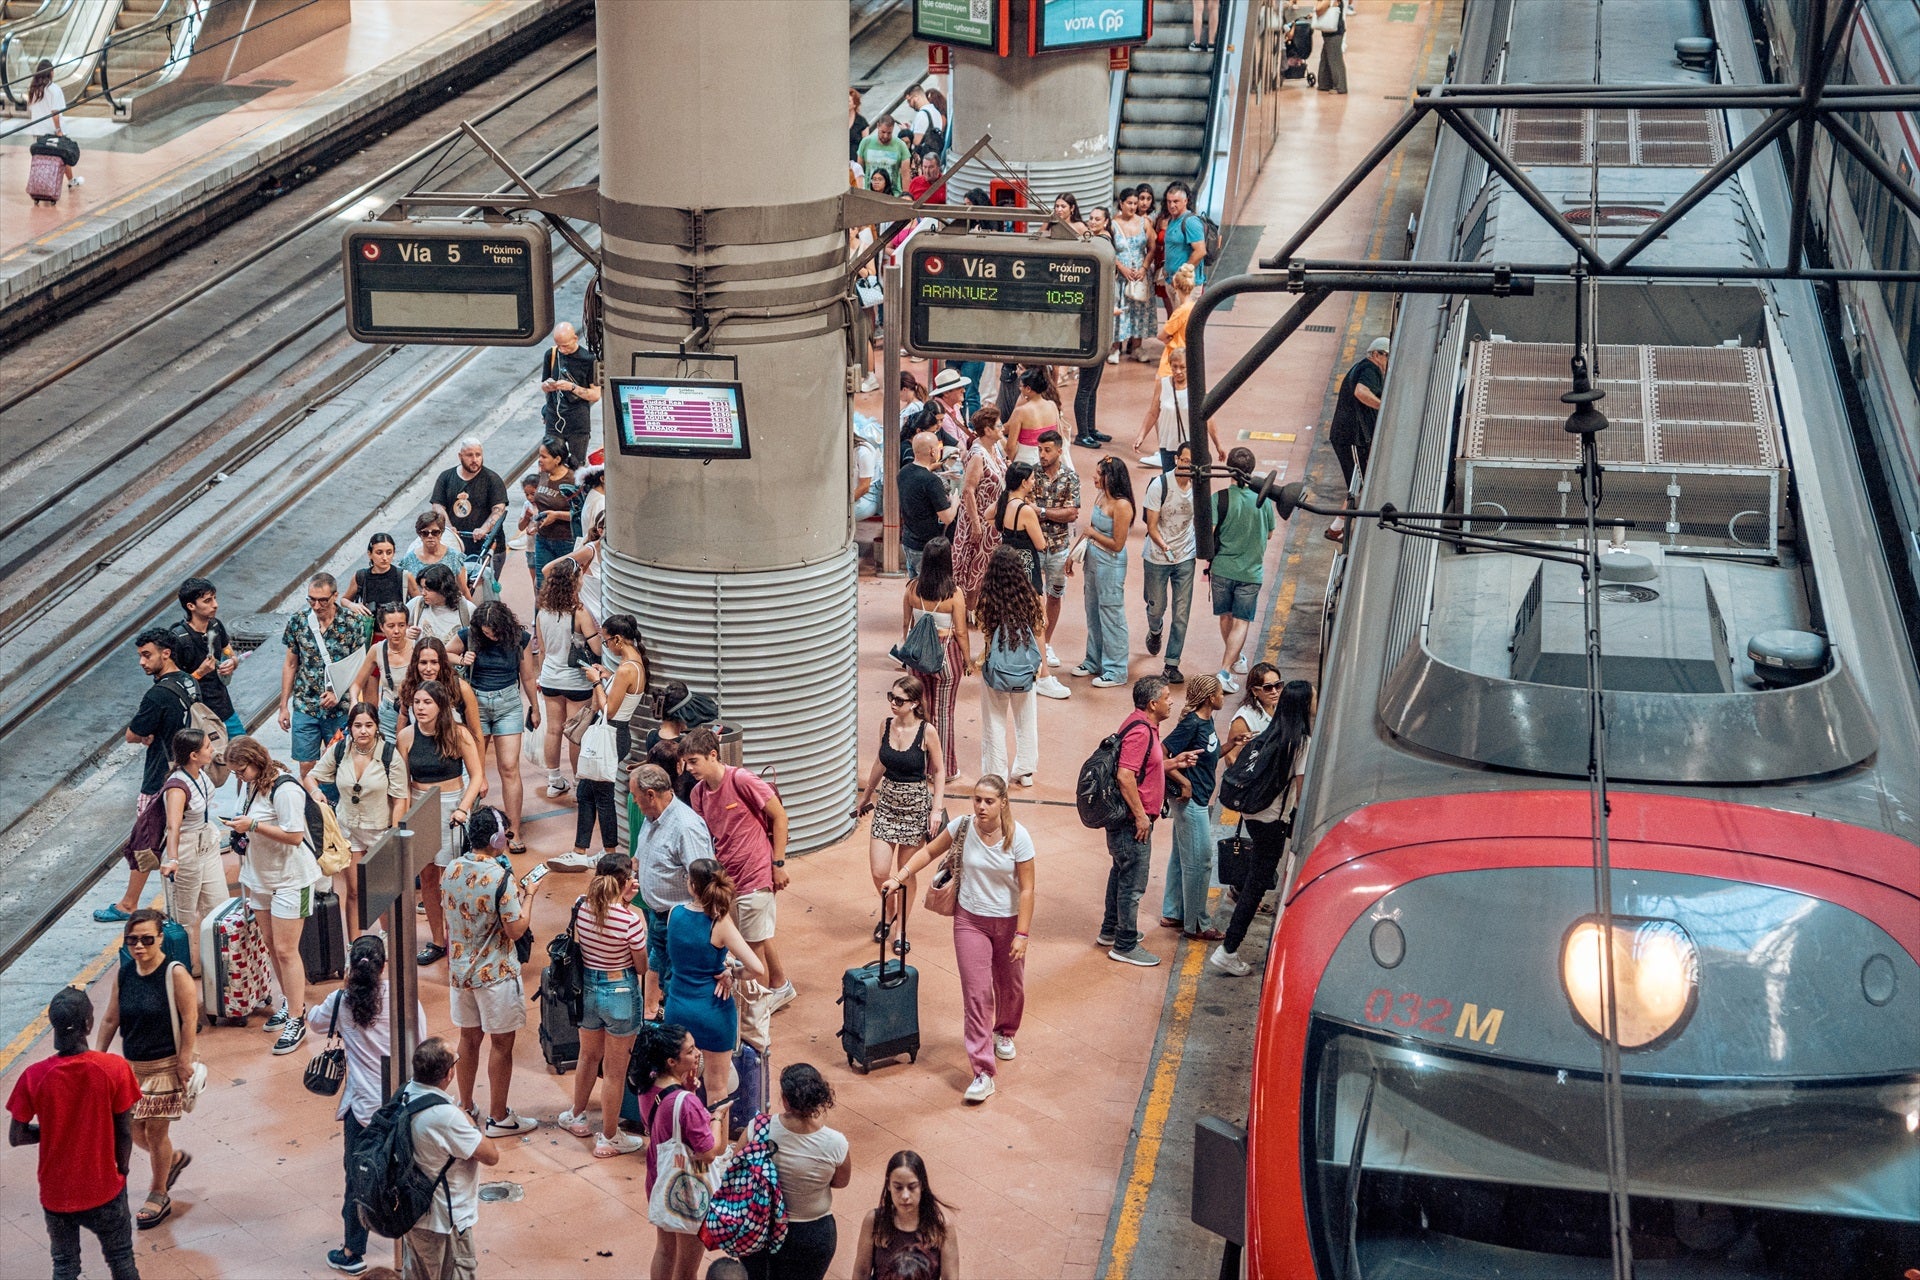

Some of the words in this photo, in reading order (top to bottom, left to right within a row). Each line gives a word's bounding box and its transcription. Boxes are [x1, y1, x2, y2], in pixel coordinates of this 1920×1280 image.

[935, 1, 967, 14] construyen
[1064, 19, 1095, 31] VOTA
[397, 243, 432, 263] Vía
[447, 244, 461, 263] 5
[482, 245, 523, 255] Próximo
[493, 255, 513, 264] tren
[962, 258, 997, 278] Vía
[1011, 260, 1026, 279] 6
[1048, 263, 1091, 274] Próximo
[1059, 273, 1080, 283] tren
[922, 284, 998, 301] ARANJUEZ
[1046, 291, 1084, 305] 10:58
